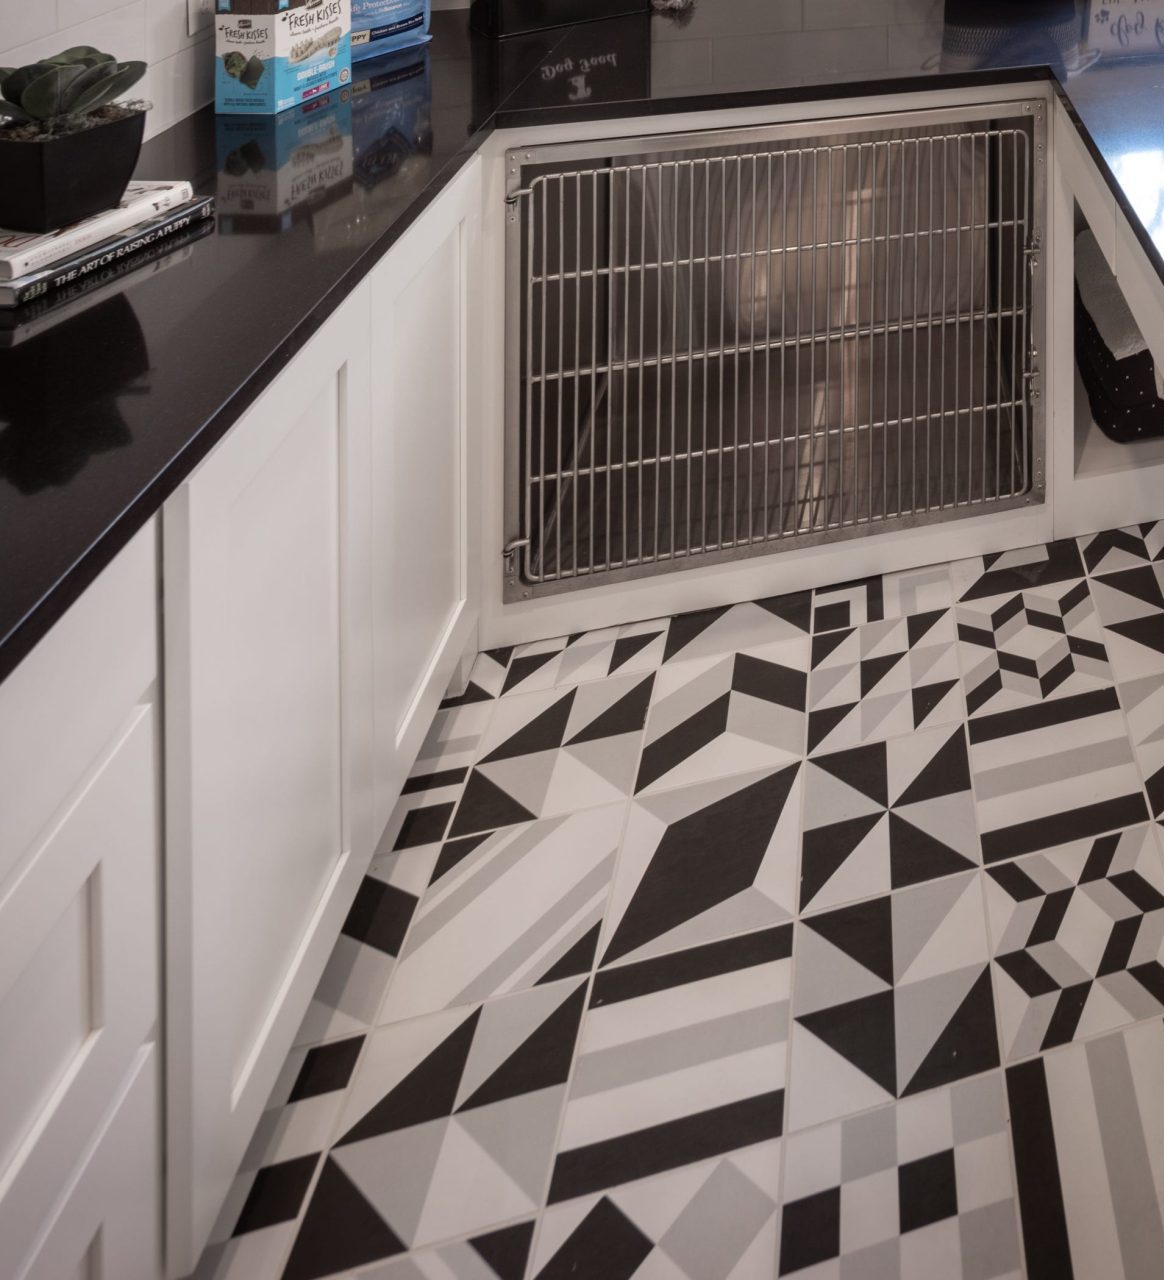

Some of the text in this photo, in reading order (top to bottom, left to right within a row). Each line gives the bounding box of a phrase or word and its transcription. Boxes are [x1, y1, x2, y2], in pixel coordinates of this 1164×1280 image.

[287, 10, 315, 30] FRESH
[315, 0, 342, 24] KISSES
[224, 27, 269, 40] FRESH KISSES
[53, 271, 79, 288] THE
[77, 258, 101, 279] ART
[99, 251, 116, 267] OF
[114, 234, 159, 262] RAISING
[163, 215, 192, 236] PUPPY
